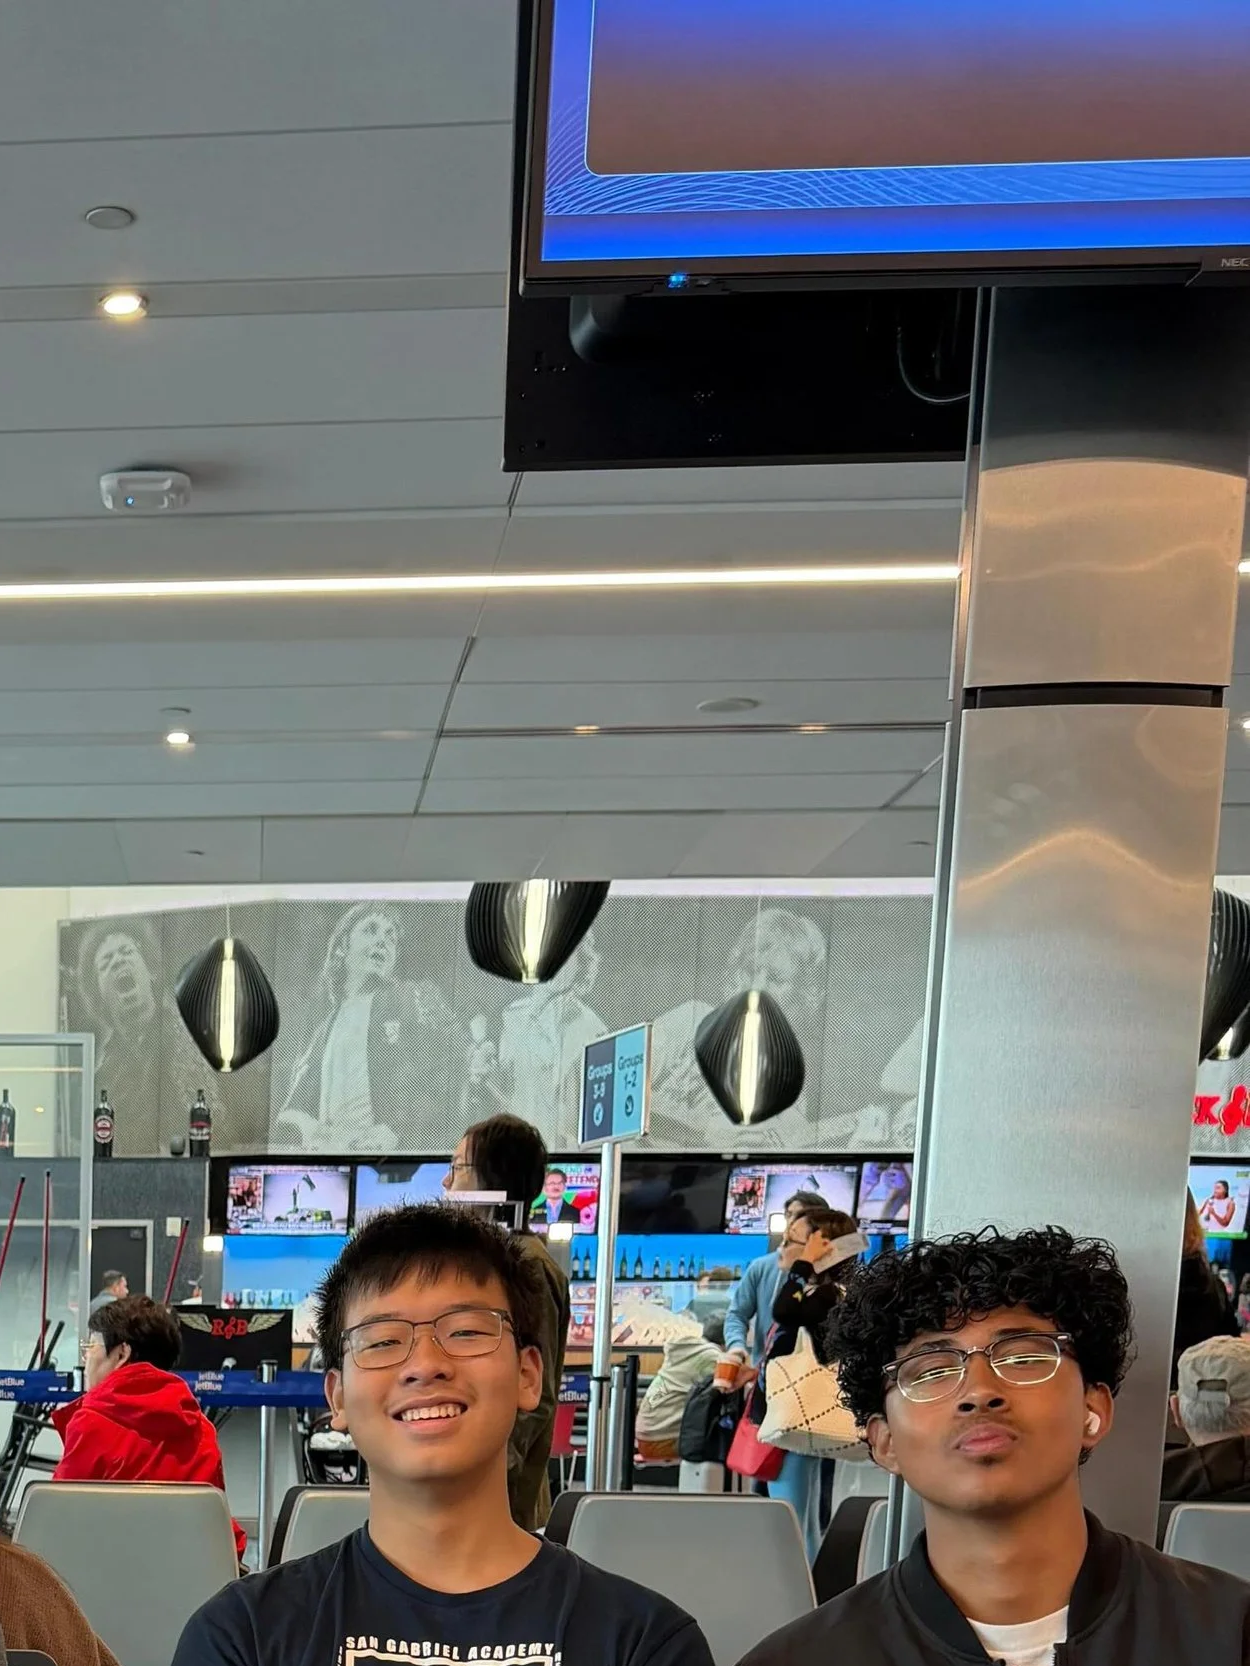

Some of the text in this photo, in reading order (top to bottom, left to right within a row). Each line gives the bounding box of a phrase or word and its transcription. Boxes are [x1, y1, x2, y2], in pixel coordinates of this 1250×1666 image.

[1221, 257, 1250, 268] NEC
[618, 1052, 644, 1071] Groups
[587, 1063, 613, 1081] Groups
[557, 1390, 588, 1402] etBlue
[346, 1636, 554, 1660] SAN GABRIEL ACADEMY
